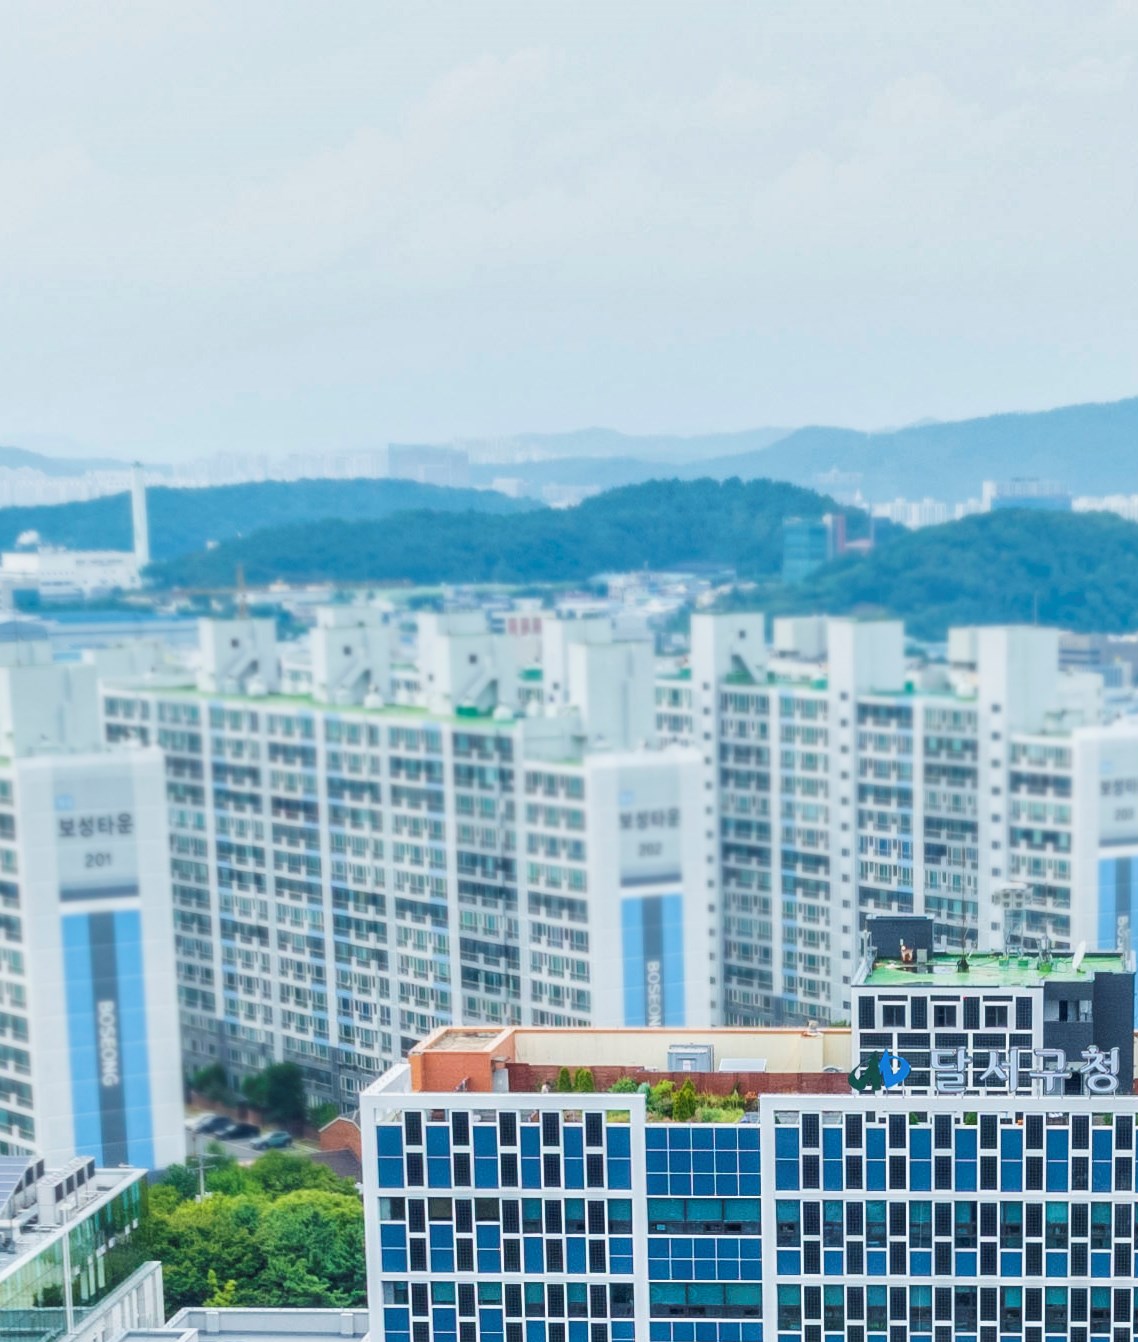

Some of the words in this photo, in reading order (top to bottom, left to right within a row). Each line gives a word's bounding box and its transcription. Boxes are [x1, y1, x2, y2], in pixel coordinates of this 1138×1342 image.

[58, 812, 135, 837] 보성타운
[619, 806, 680, 830] 보성타운
[84, 852, 113, 869] 201
[98, 1000, 119, 1087] BOSEONG
[930, 1044, 1120, 1093] 달서구청
